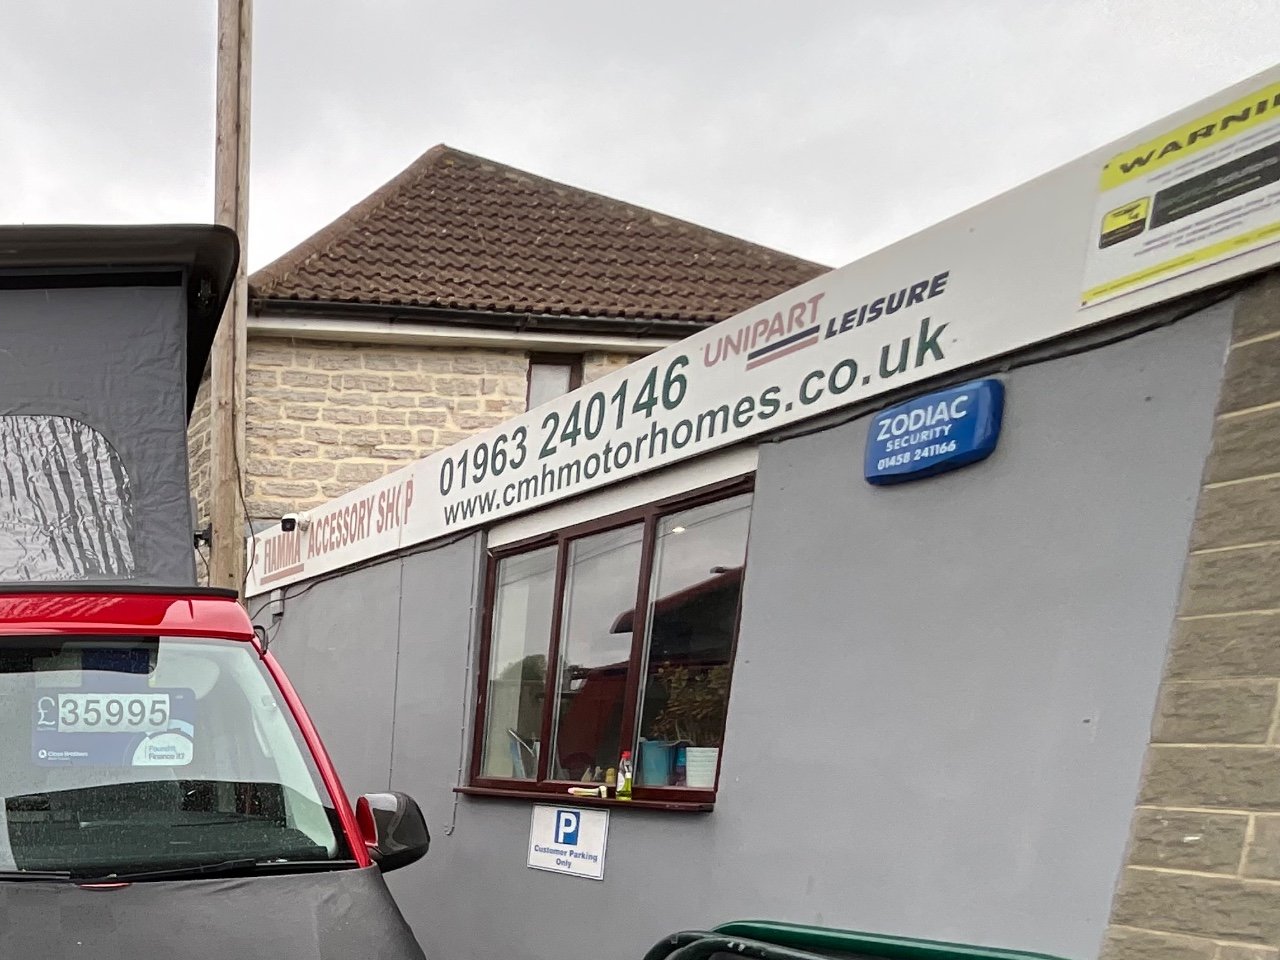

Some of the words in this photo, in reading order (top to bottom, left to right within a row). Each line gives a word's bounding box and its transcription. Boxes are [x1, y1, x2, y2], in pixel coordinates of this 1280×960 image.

[1119, 92, 1280, 174] WARNI
[703, 292, 825, 368] UNIPART
[824, 270, 950, 340] LEISURE
[439, 425, 528, 497] 01963
[538, 354, 689, 461] 240146
[443, 316, 950, 526] www.cmhmotorhomes.co.uk
[876, 395, 969, 442] ZODIAC
[885, 424, 953, 453] SECURITY
[877, 451, 911, 471] 01458
[913, 439, 957, 462] 241166
[307, 495, 375, 559] ACCESSORY
[557, 811, 578, 843] P
[534, 844, 568, 856] Customer
[569, 849, 598, 864] Parking
[555, 858, 572, 869] Only
